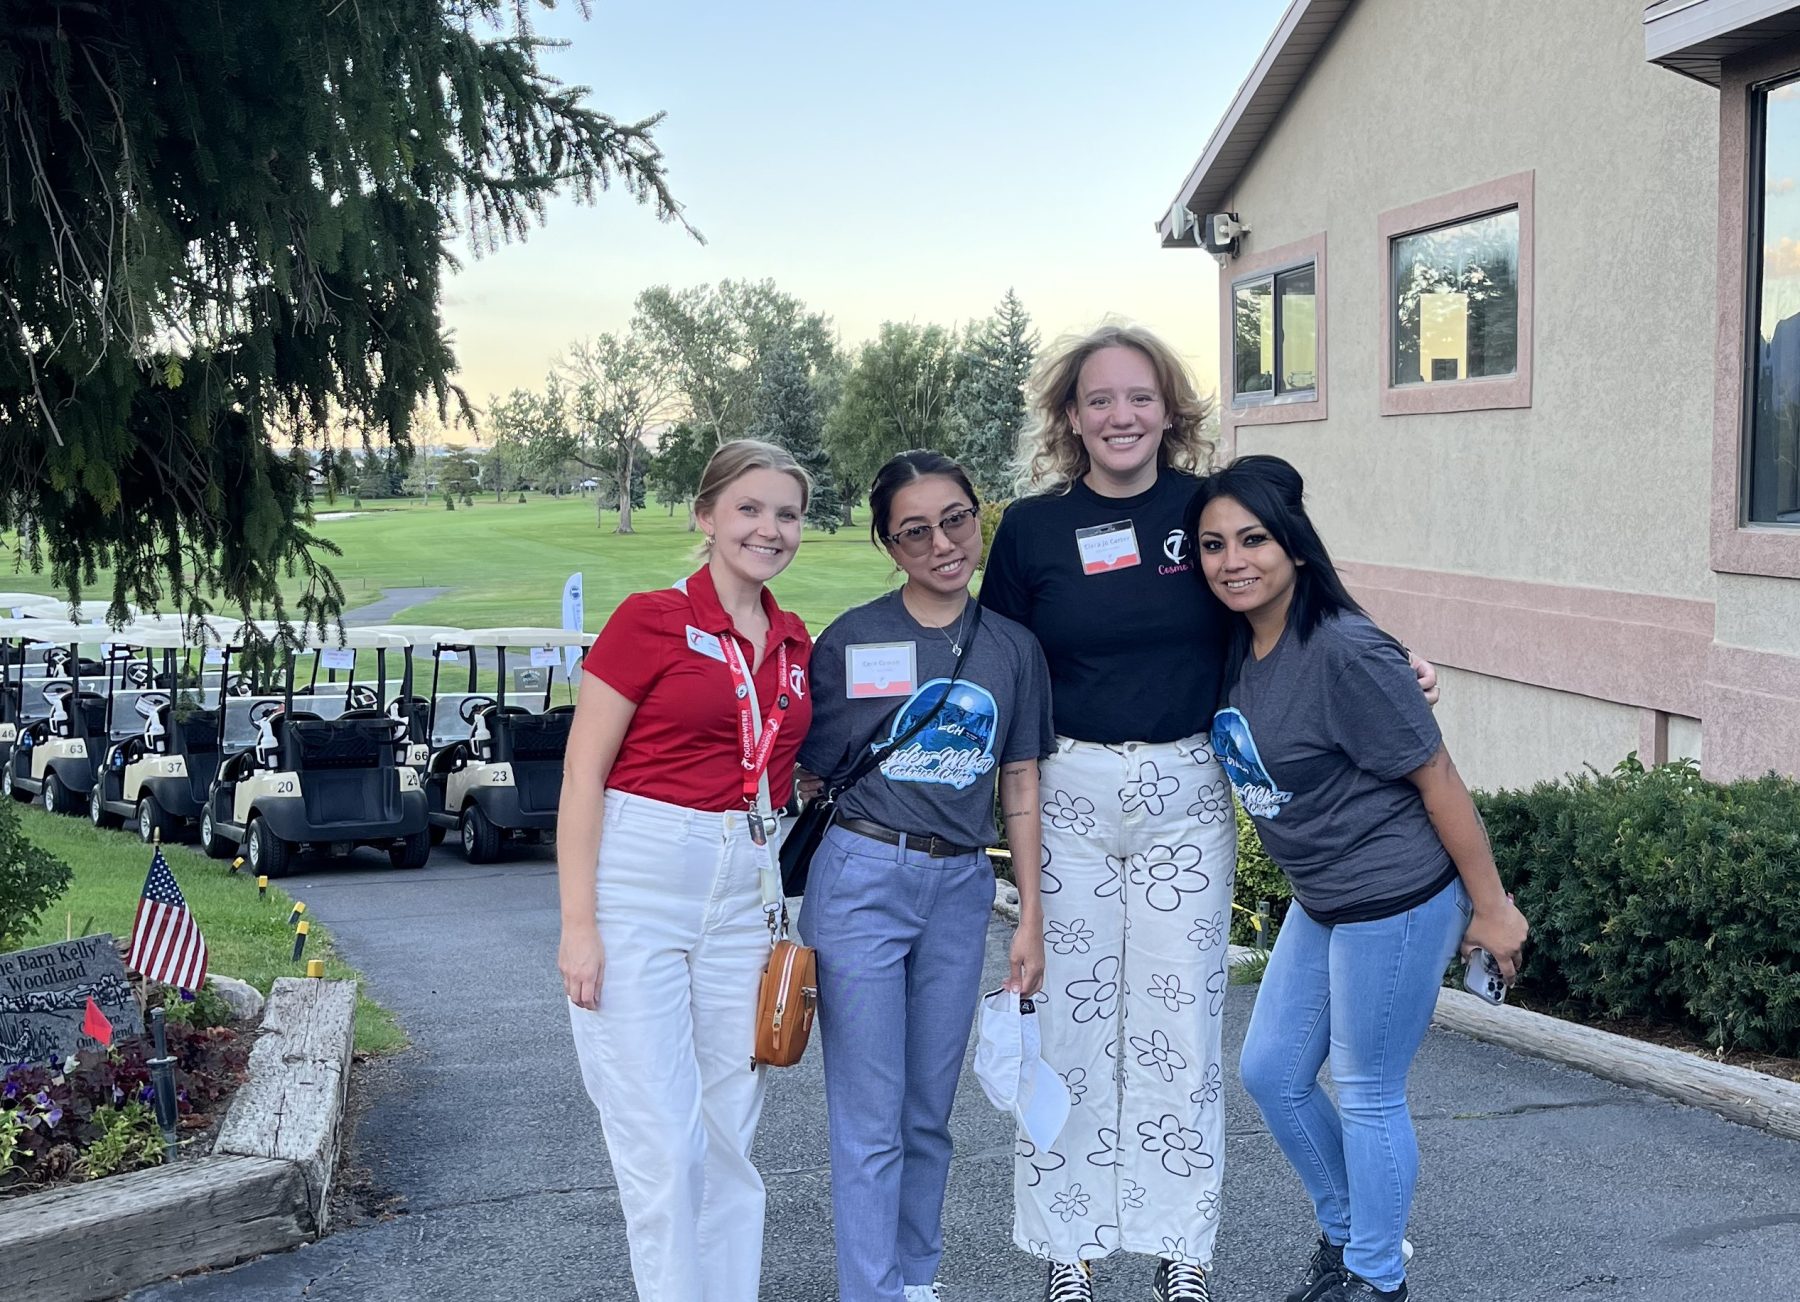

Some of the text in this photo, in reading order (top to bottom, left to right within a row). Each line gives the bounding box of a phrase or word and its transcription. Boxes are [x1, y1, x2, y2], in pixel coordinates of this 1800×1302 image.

[1, 730, 15, 738] 46
[741, 709, 751, 758] OGDEN-WEBER
[70, 745, 83, 753] 63
[414, 751, 428, 761] 66
[167, 762, 182, 773] 37
[492, 770, 507, 782] 23
[277, 781, 294, 793] 20
[16, 953, 56, 972] Barn
[6, 960, 88, 993] Woodland
